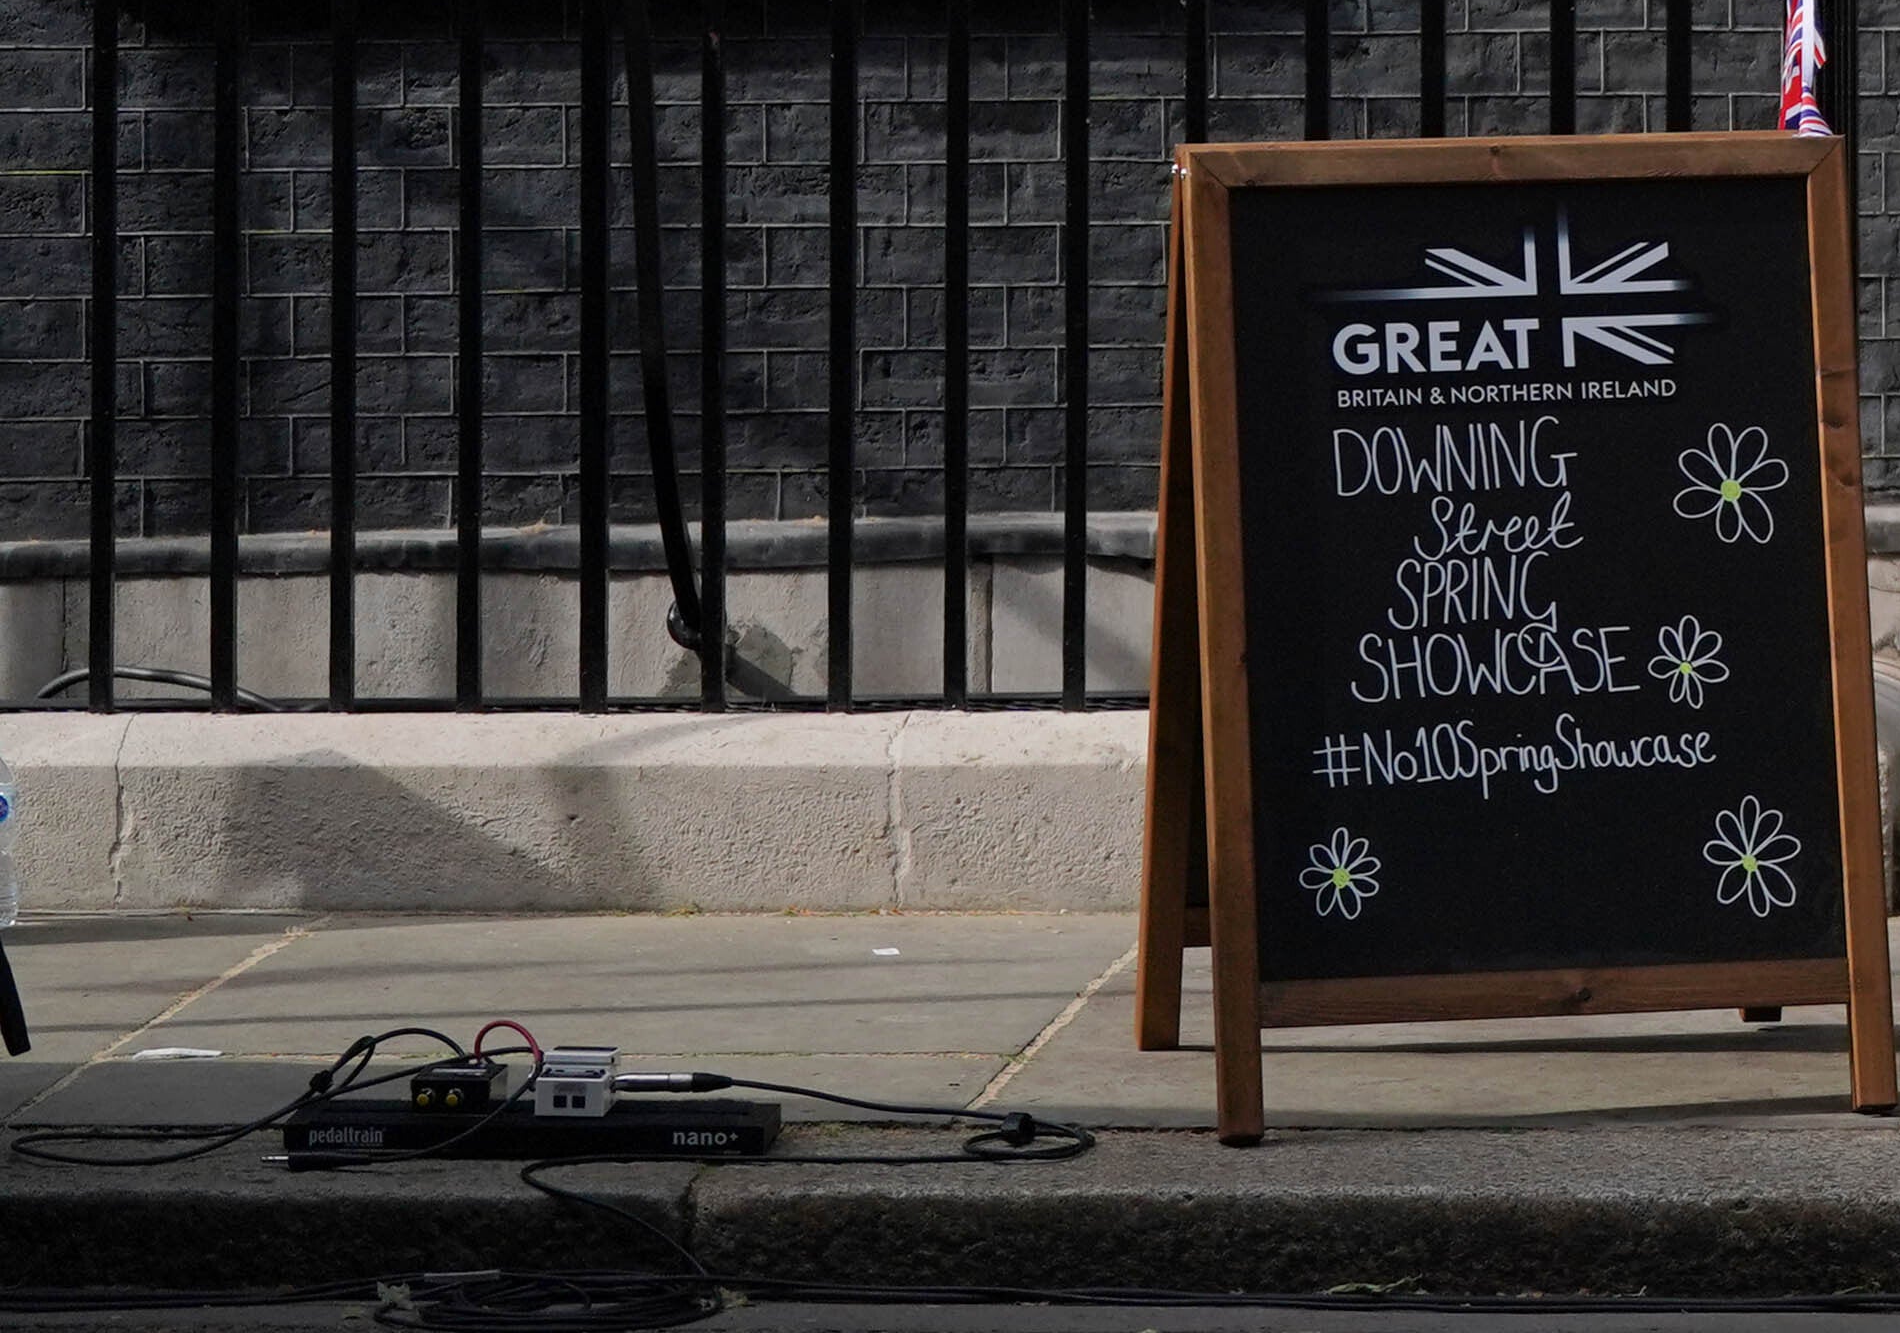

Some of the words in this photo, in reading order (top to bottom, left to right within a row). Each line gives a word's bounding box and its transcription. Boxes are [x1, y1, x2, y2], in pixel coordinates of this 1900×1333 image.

[1332, 317, 1541, 376] GREAT
[1336, 386, 1423, 409] BRITAIN
[1428, 386, 1446, 406] &
[1450, 381, 1573, 404] NORTHERN
[1580, 378, 1677, 400] IRELAND
[1332, 414, 1579, 498] DOWNING
[1411, 490, 1584, 560] Street
[1387, 551, 1559, 670] SPRING
[1350, 624, 1642, 704] SHOWCASE
[1312, 712, 1717, 800] #No10SpringShowcase
[308, 1126, 384, 1145] pedaltrain
[671, 1128, 740, 1147] nano+
